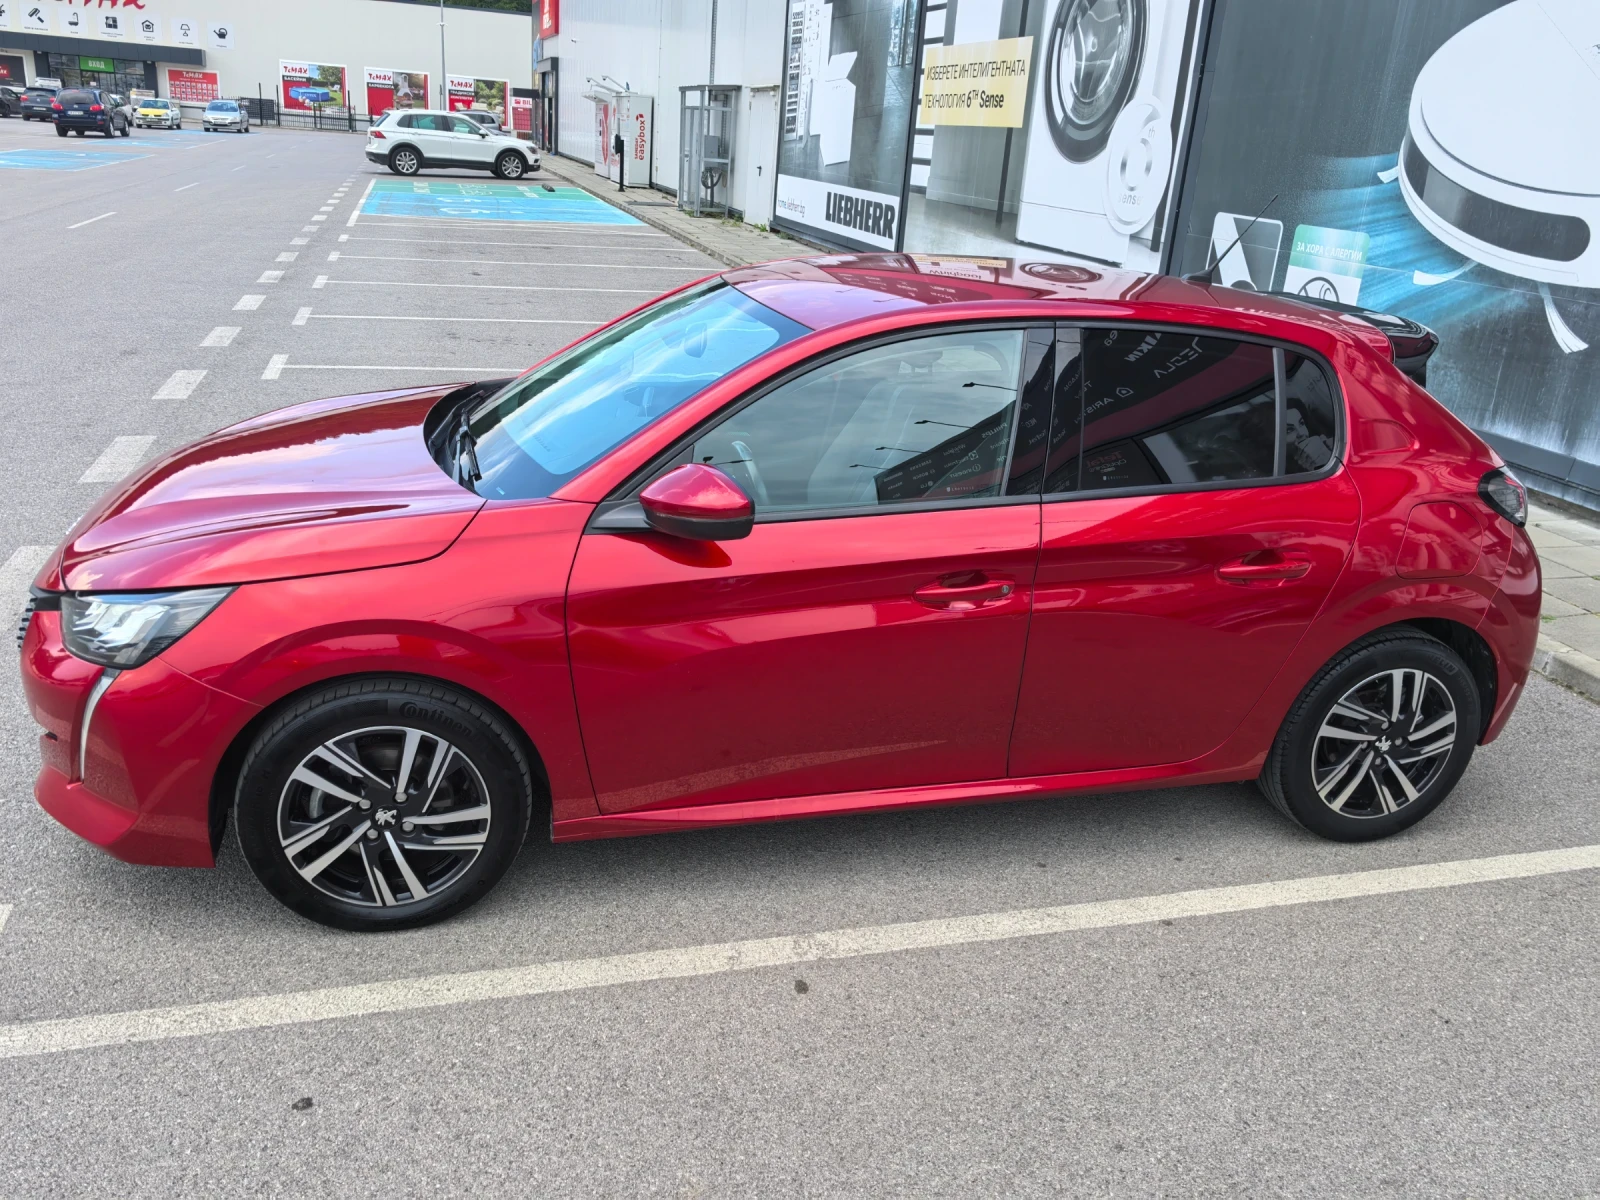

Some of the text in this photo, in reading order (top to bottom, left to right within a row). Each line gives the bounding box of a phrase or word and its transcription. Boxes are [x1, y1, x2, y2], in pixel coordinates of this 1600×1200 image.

[88, 60, 105, 69] ВХОД
[926, 59, 1026, 80] ИЗБЕРЕТЕ ИНТЕЛИГЕНТНАТА
[924, 93, 966, 109] ТЕХНОЛОГИЯ
[979, 90, 1005, 109] Sense
[638, 119, 647, 161] easybox
[825, 191, 896, 240] LIEBHERR
[1296, 241, 1305, 251] ЗА
[1305, 243, 1324, 255] ХОРА
[1330, 247, 1363, 261] АЛЕРГИИ
